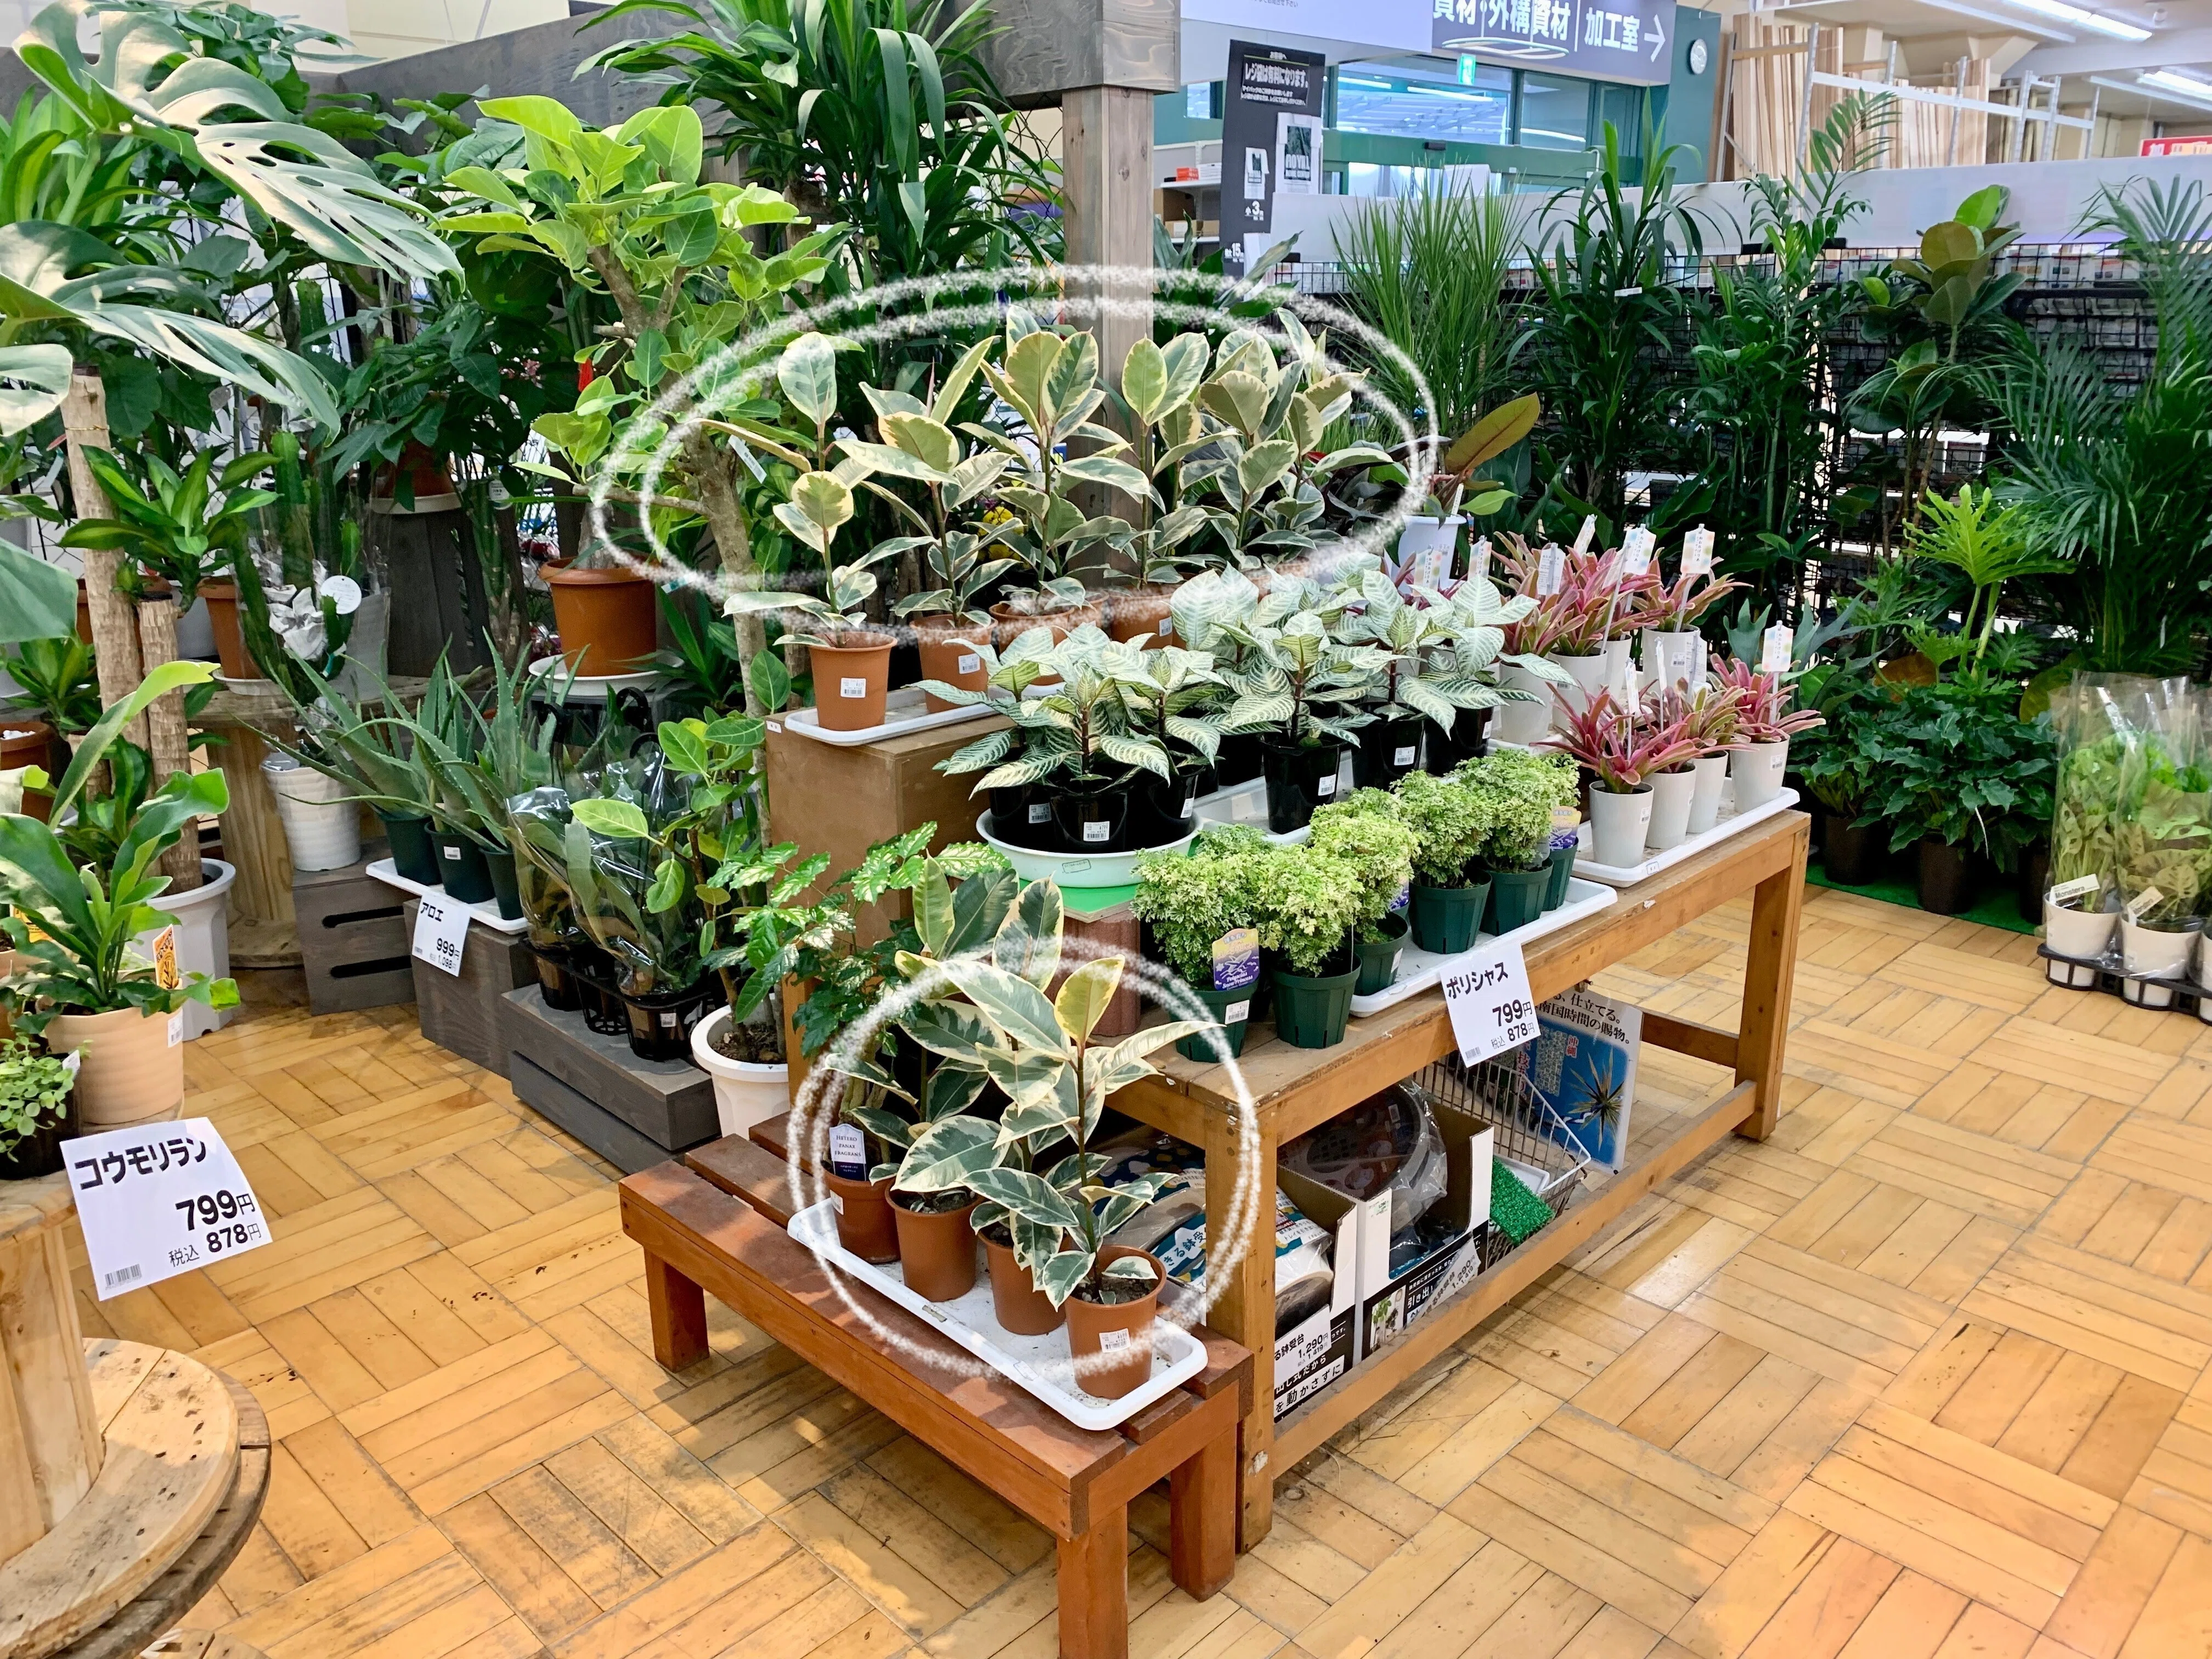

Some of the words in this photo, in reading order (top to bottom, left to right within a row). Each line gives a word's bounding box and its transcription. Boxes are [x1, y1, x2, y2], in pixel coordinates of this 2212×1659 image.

[1584, 7, 1640, 52] 加工室
[2055, 885, 2085, 899] Monstera
[420, 902, 444, 922] アロエ
[437, 938, 460, 961] 999円
[1222, 981, 1235, 989] Snow
[1234, 975, 1254, 985] Princess
[1227, 972, 1248, 982] Polyscias
[1447, 962, 1509, 999] ポリシャス
[1492, 999, 1533, 1027] 799円
[1536, 1001, 1629, 1044] 南国時間の賜物。
[1491, 1036, 1506, 1049] 税込
[1507, 1022, 1536, 1042] 878円
[1566, 1035, 1579, 1058] 沖縄
[75, 1137, 207, 1190] コウモリラン
[176, 1189, 256, 1231] 799円
[168, 1244, 200, 1268] 税込
[206, 1223, 262, 1254] 878円
[1276, 1364, 1341, 1413] を動かさずに
